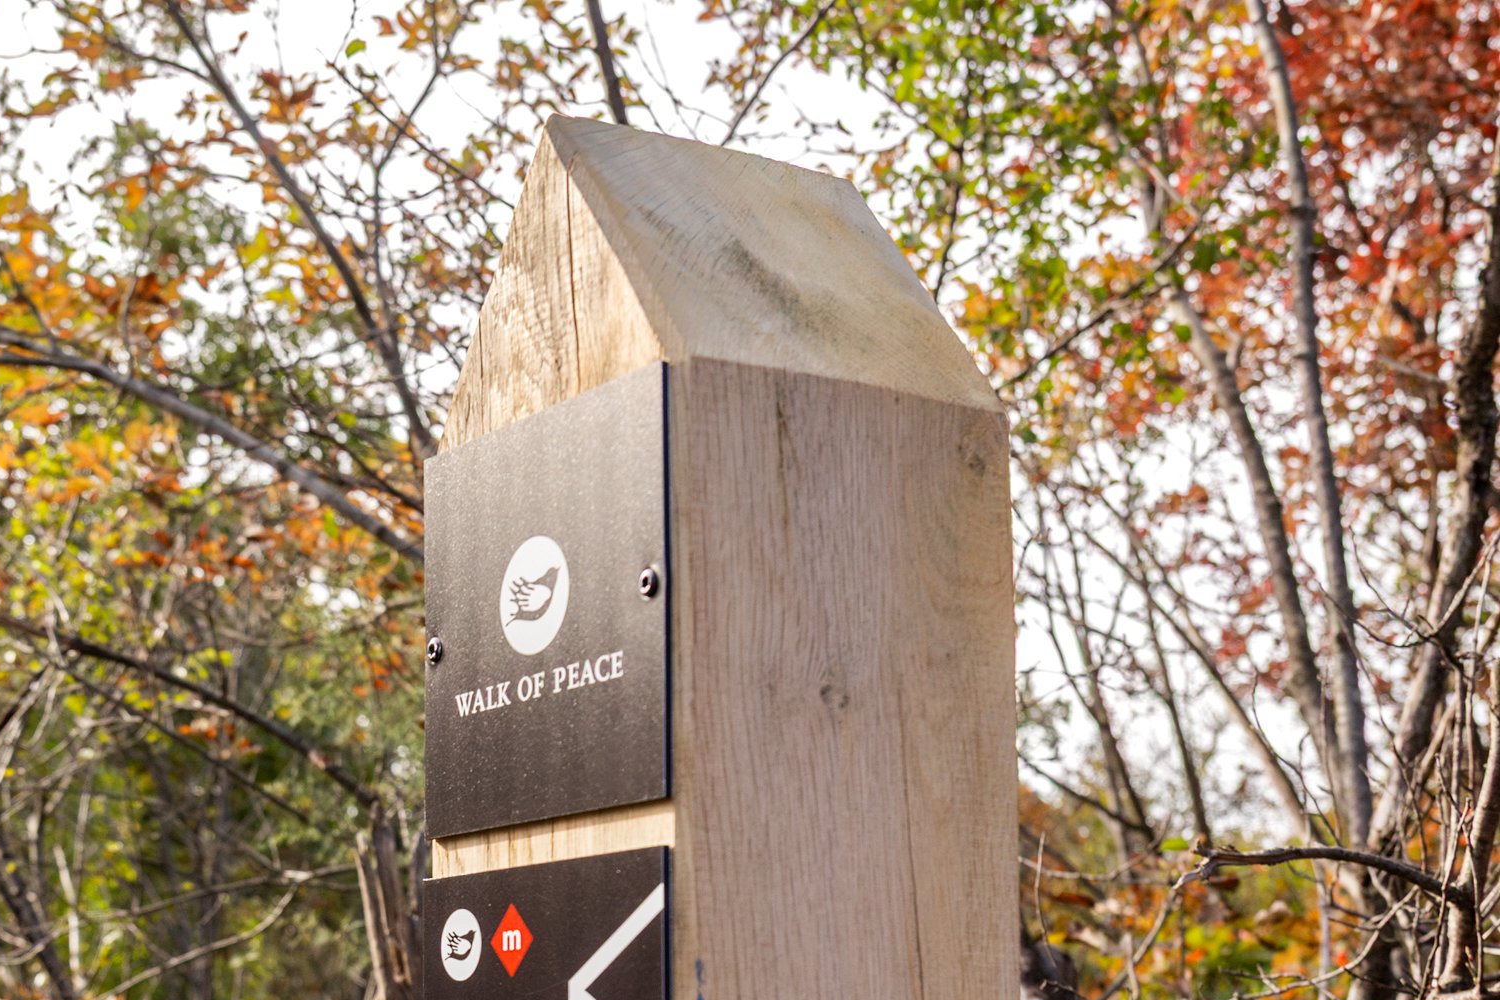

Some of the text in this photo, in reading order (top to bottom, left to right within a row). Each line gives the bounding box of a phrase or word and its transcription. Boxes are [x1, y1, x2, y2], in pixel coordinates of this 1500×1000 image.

[455, 651, 624, 718] WALK OF PEACE
